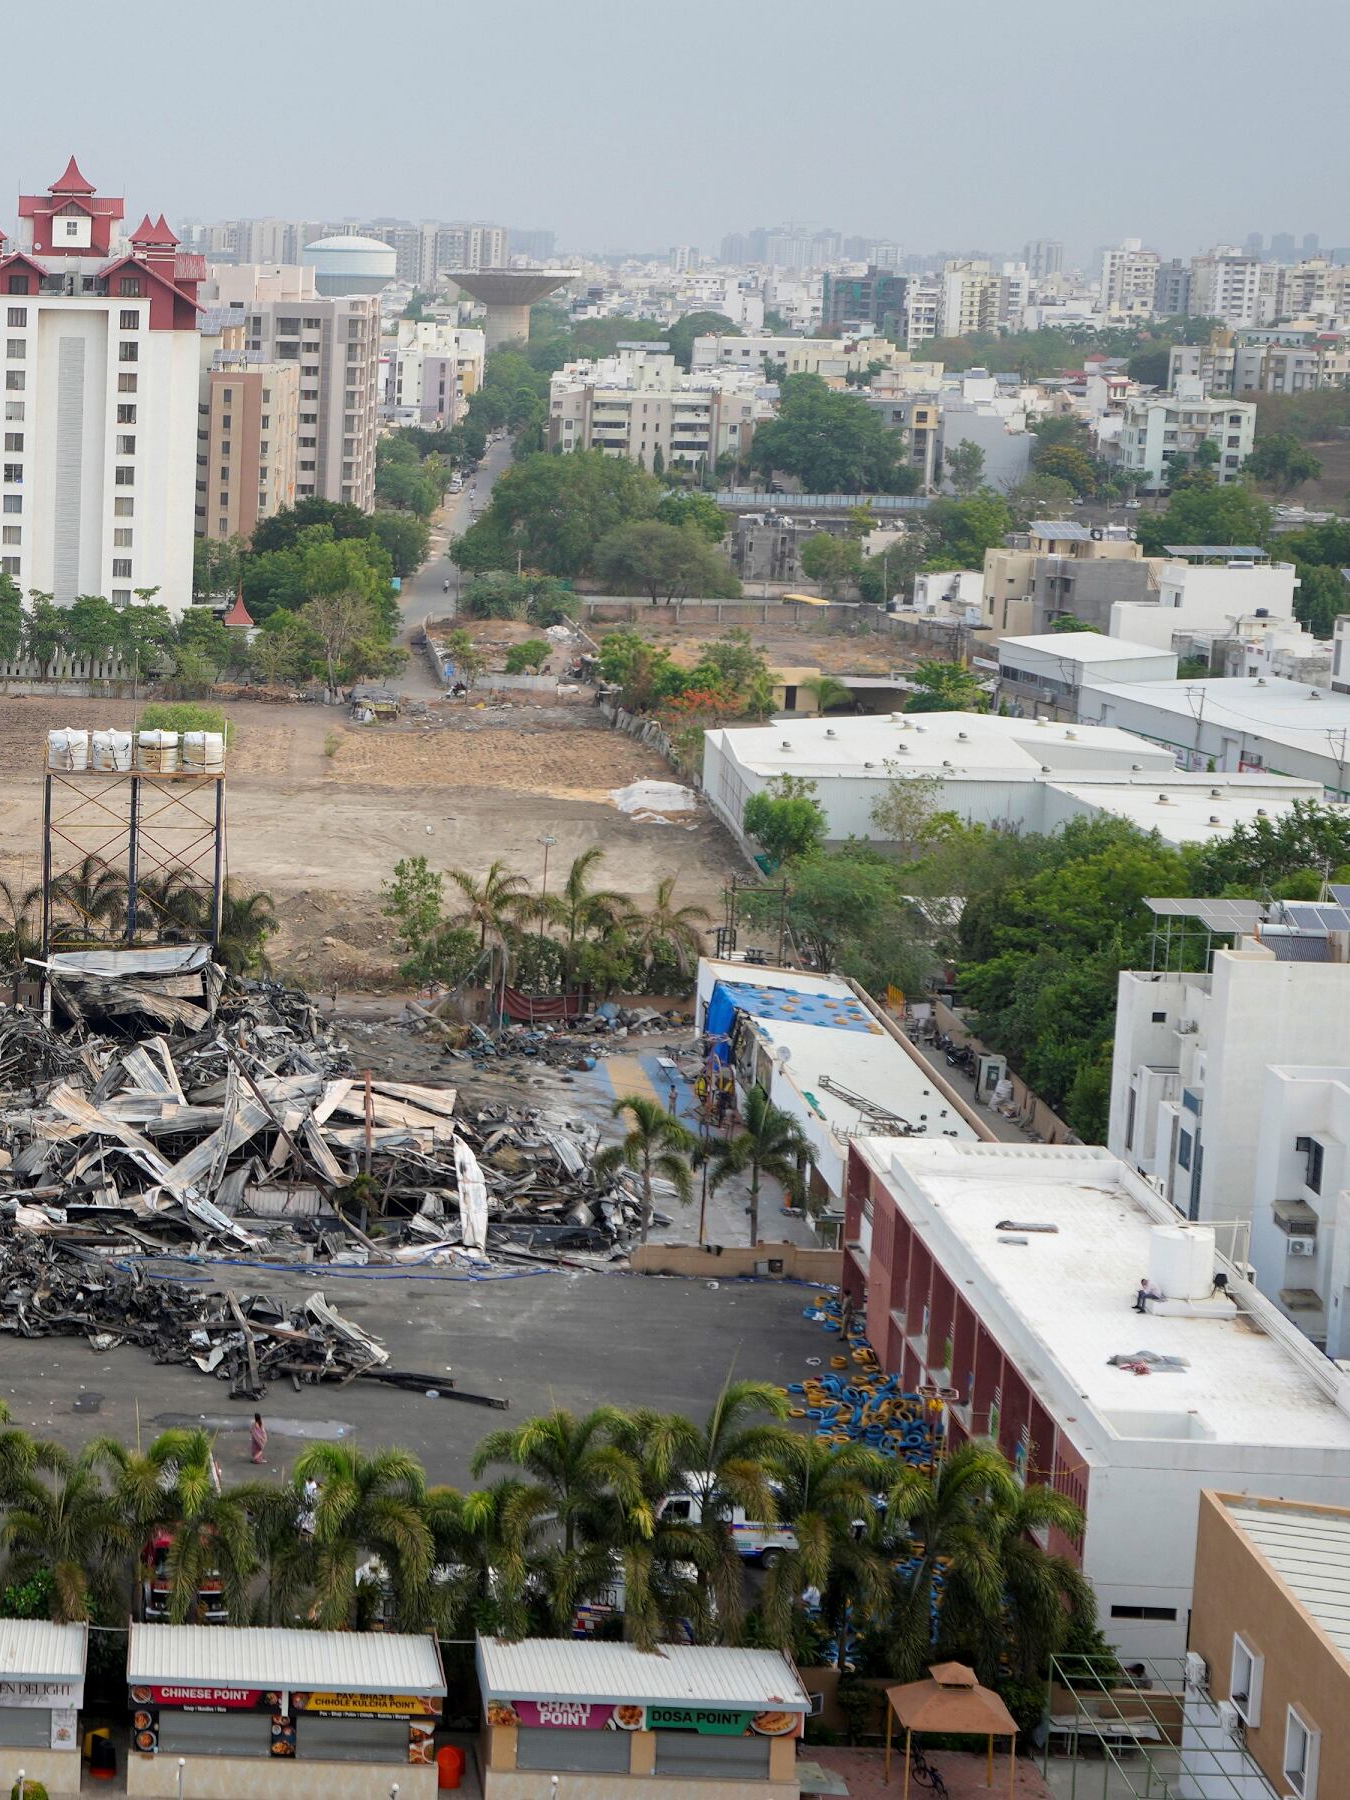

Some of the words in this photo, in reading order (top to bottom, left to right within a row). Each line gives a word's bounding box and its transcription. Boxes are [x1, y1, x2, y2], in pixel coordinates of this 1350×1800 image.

[18, 1683, 71, 1696] DELIGHT
[161, 1687, 212, 1699] CHINESE
[213, 1689, 249, 1700] POINT
[315, 1698, 350, 1707] CHHOLE
[352, 1699, 388, 1708] KULCHA
[389, 1701, 416, 1709] POINT
[536, 1701, 591, 1713] CHAAT
[539, 1712, 590, 1726] POINT
[652, 1710, 692, 1723] DOSA
[696, 1712, 741, 1725] POINT
